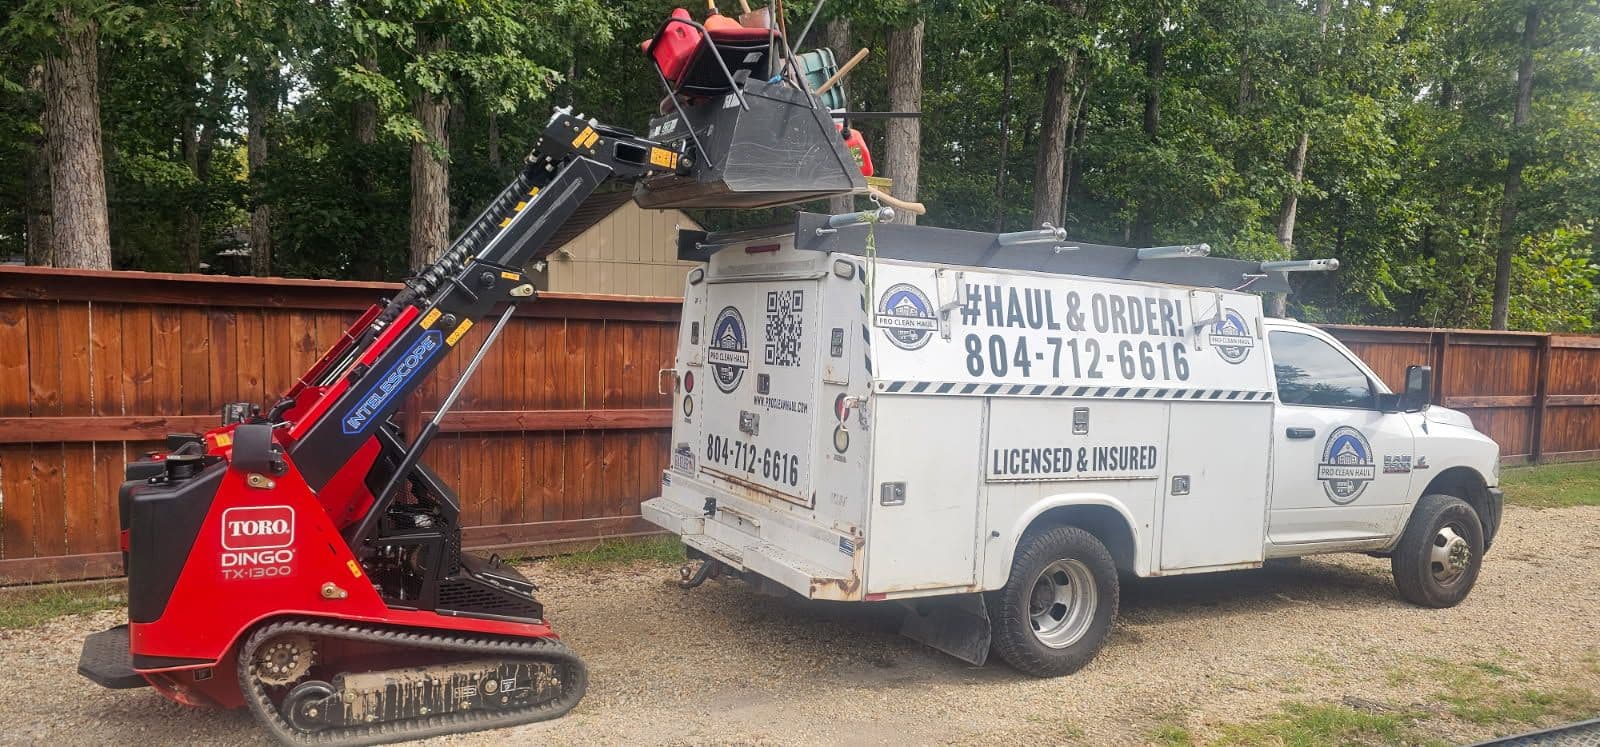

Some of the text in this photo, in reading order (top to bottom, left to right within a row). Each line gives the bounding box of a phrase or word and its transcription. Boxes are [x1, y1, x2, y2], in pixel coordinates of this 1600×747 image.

[879, 317, 893, 325] PRO
[916, 320, 933, 328] HAUL
[960, 284, 1061, 330] #HAUL
[1066, 291, 1086, 332] &
[1091, 292, 1185, 337] ORDER!
[964, 333, 1190, 381] 804-712-6616
[347, 335, 436, 429] INTELESCOPE
[707, 433, 799, 487] 804-712-6616
[993, 445, 1157, 475] LICENSED & INSURED
[1321, 468, 1372, 477] PRO CLEAN HAUL
[228, 519, 289, 536] TORO
[221, 549, 293, 567] DINGO
